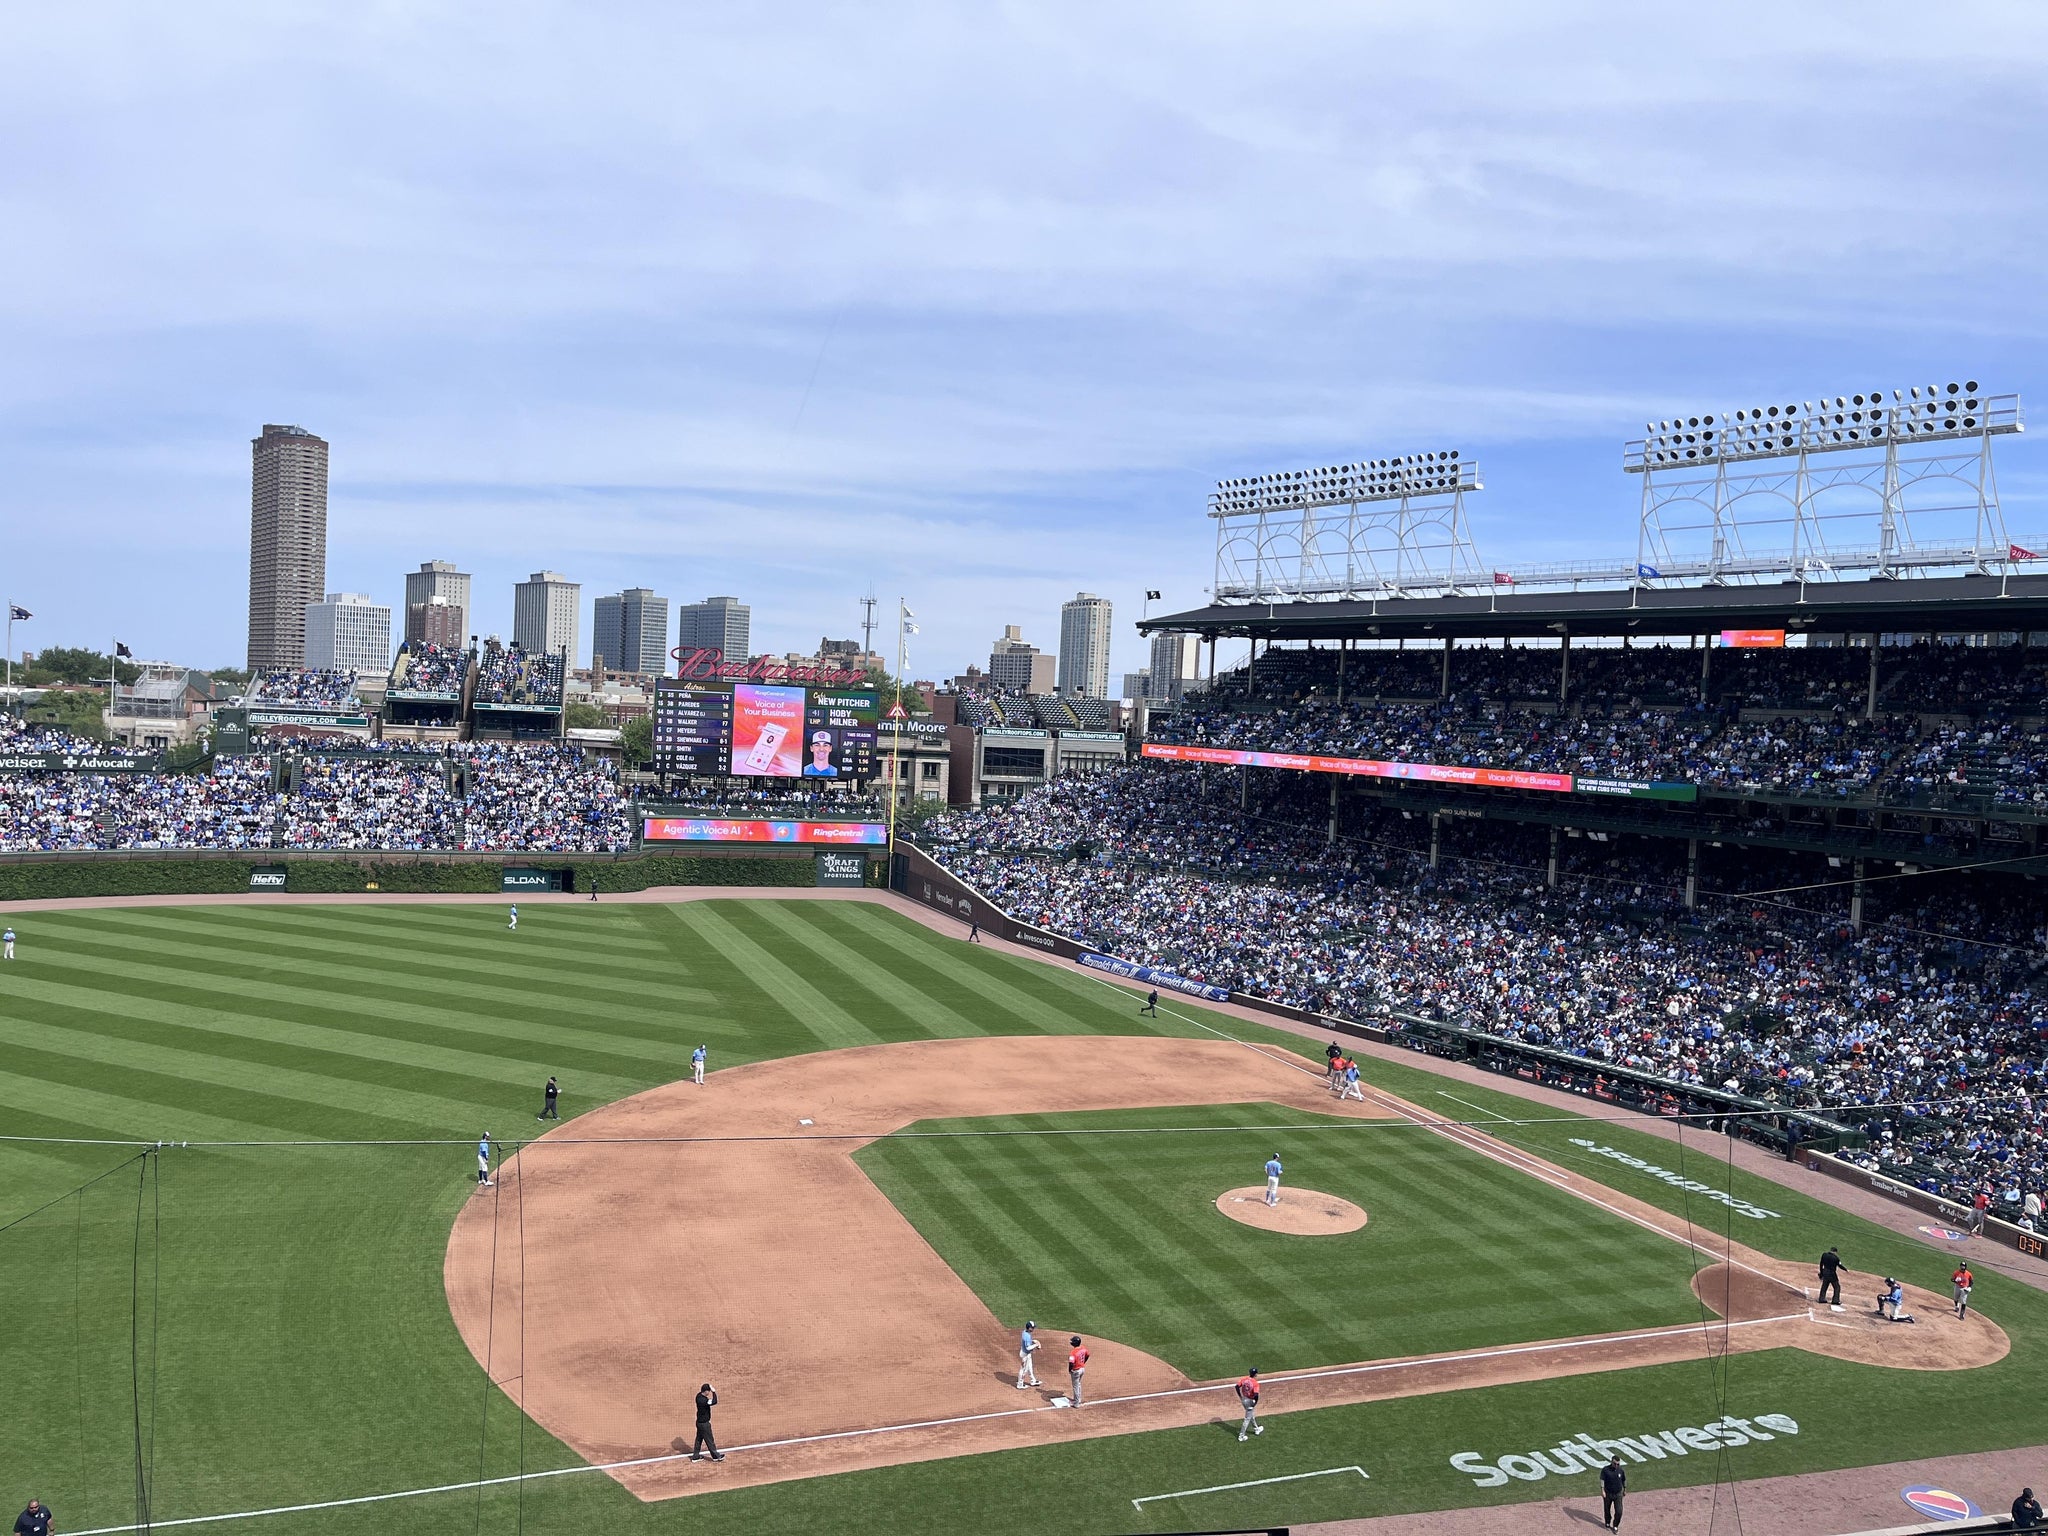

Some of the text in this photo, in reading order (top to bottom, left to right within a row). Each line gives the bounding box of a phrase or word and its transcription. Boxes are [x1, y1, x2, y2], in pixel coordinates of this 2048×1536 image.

[670, 646, 869, 683] Budweiser
[684, 682, 706, 690] Astros
[818, 697, 870, 707] NEW PITCHER
[762, 708, 795, 717] Business
[830, 709, 852, 717] HOBY
[830, 718, 858, 726] MILNER
[878, 720, 946, 733] min Moore
[1062, 732, 1120, 740] WRIGLEYROOFTOPS.COM
[1147, 747, 1178, 756] RingCentral
[80, 758, 134, 768] Advocate
[1273, 757, 1310, 766] RingCentral
[1320, 760, 1333, 768] Voice
[1353, 762, 1378, 771] Business
[1430, 768, 1560, 786] RingCentral Voice of Your Business
[1468, 809, 1482, 817] level
[663, 825, 740, 835] Agentic Voice AI
[813, 828, 864, 838] RingCentral
[825, 857, 859, 867] DRAFT
[829, 865, 859, 873] KINGS
[253, 876, 282, 884] Hefty
[1024, 932, 1054, 947] Invesco QQQ
[1083, 955, 1128, 977] Reynolds Wrap
[1148, 971, 1202, 994] Reynolds Wrap
[1587, 1146, 1781, 1219] Southwest
[1871, 1177, 1908, 1198] TimberTech
[1449, 1415, 1775, 1487] Southwest
